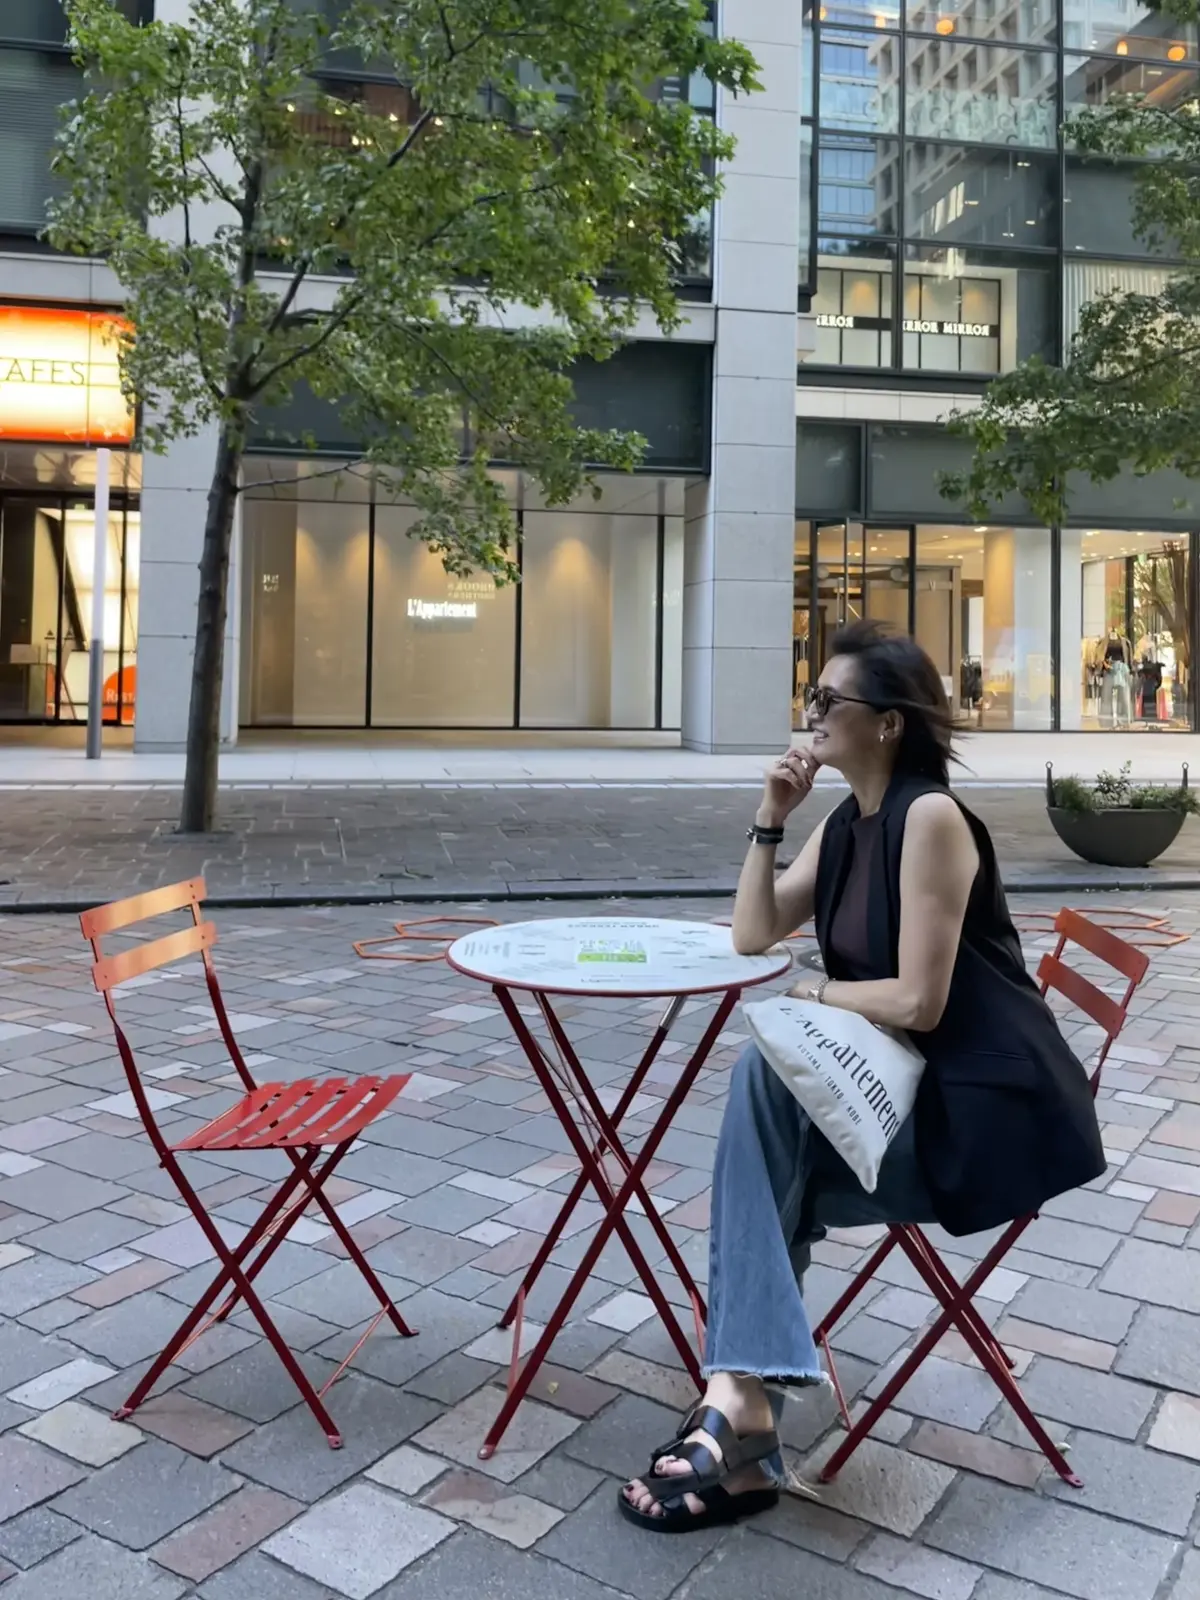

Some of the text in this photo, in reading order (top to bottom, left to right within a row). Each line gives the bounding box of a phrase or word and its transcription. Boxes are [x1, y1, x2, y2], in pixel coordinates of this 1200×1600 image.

[0, 357, 85, 386] AFES
[825, 1076, 844, 1100] TOKYO
[846, 1105, 861, 1125] KOBE
